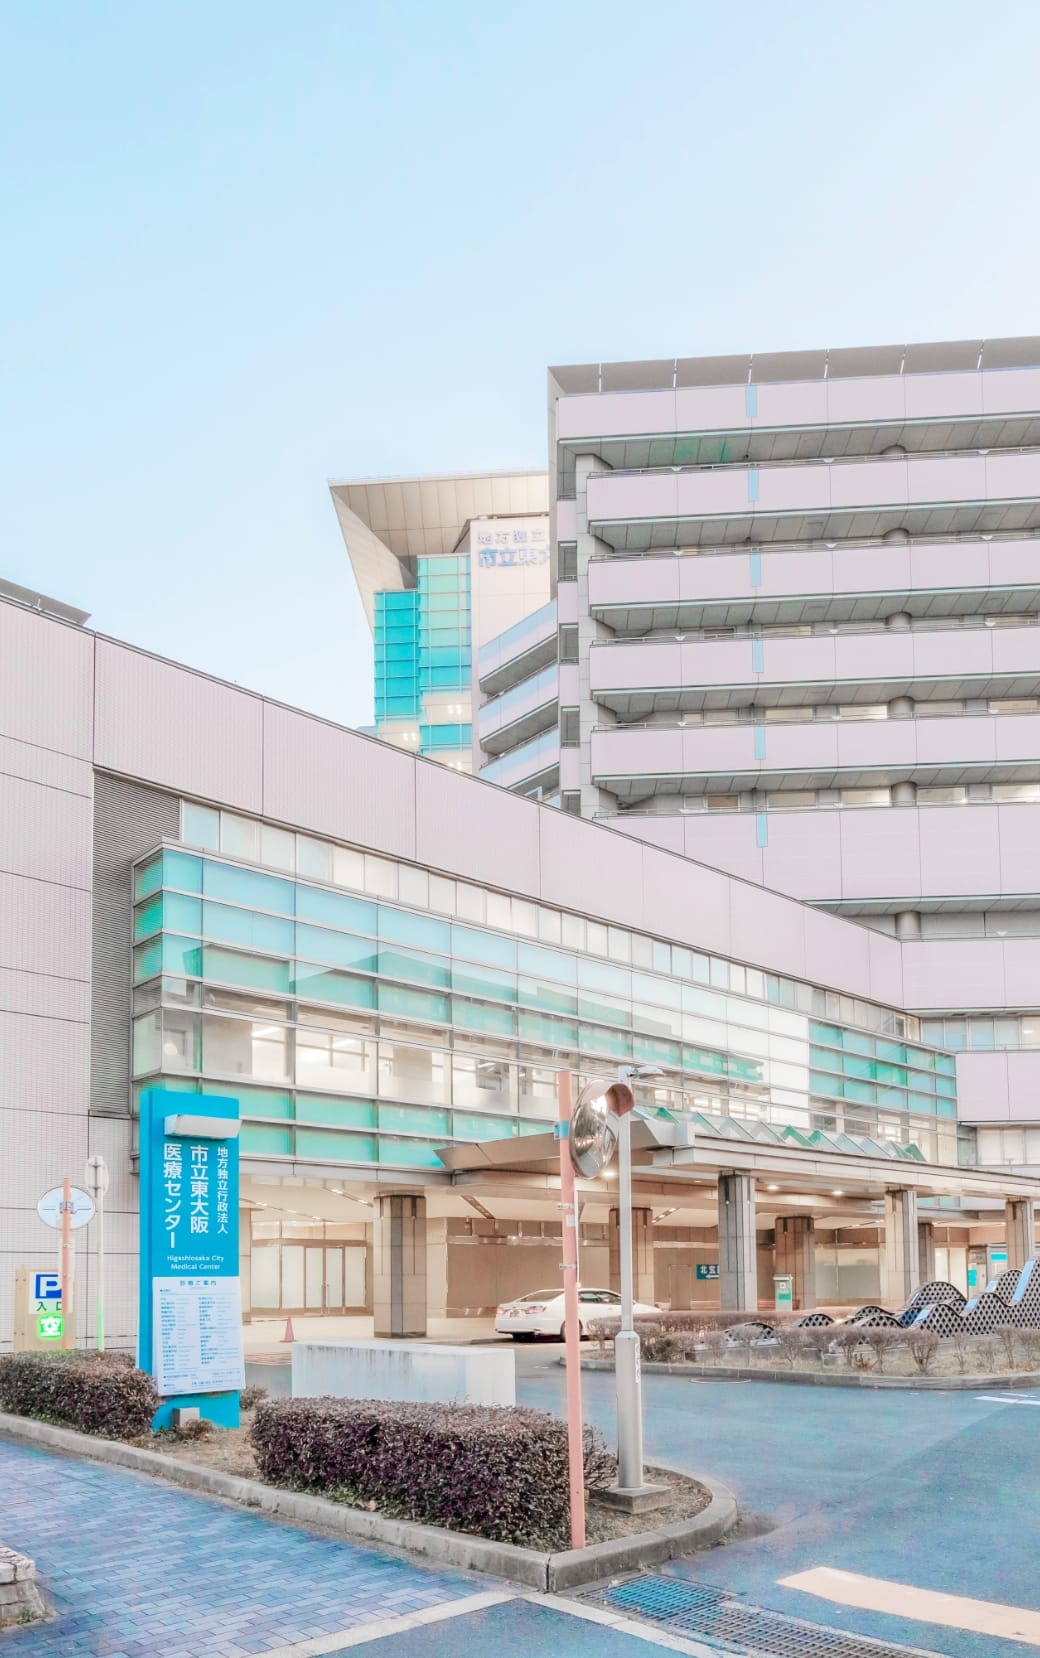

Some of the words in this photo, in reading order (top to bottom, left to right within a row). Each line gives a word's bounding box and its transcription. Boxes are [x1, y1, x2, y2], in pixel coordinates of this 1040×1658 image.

[163, 1143, 182, 1249] 医療センター
[190, 1145, 209, 1234] 市立東大阪
[217, 1146, 229, 1234] 地方独立行政法人
[167, 1255, 210, 1263] Higashiosaka
[211, 1255, 225, 1263] City
[36, 1301, 62, 1311] 入口
[39, 1276, 62, 1297] P
